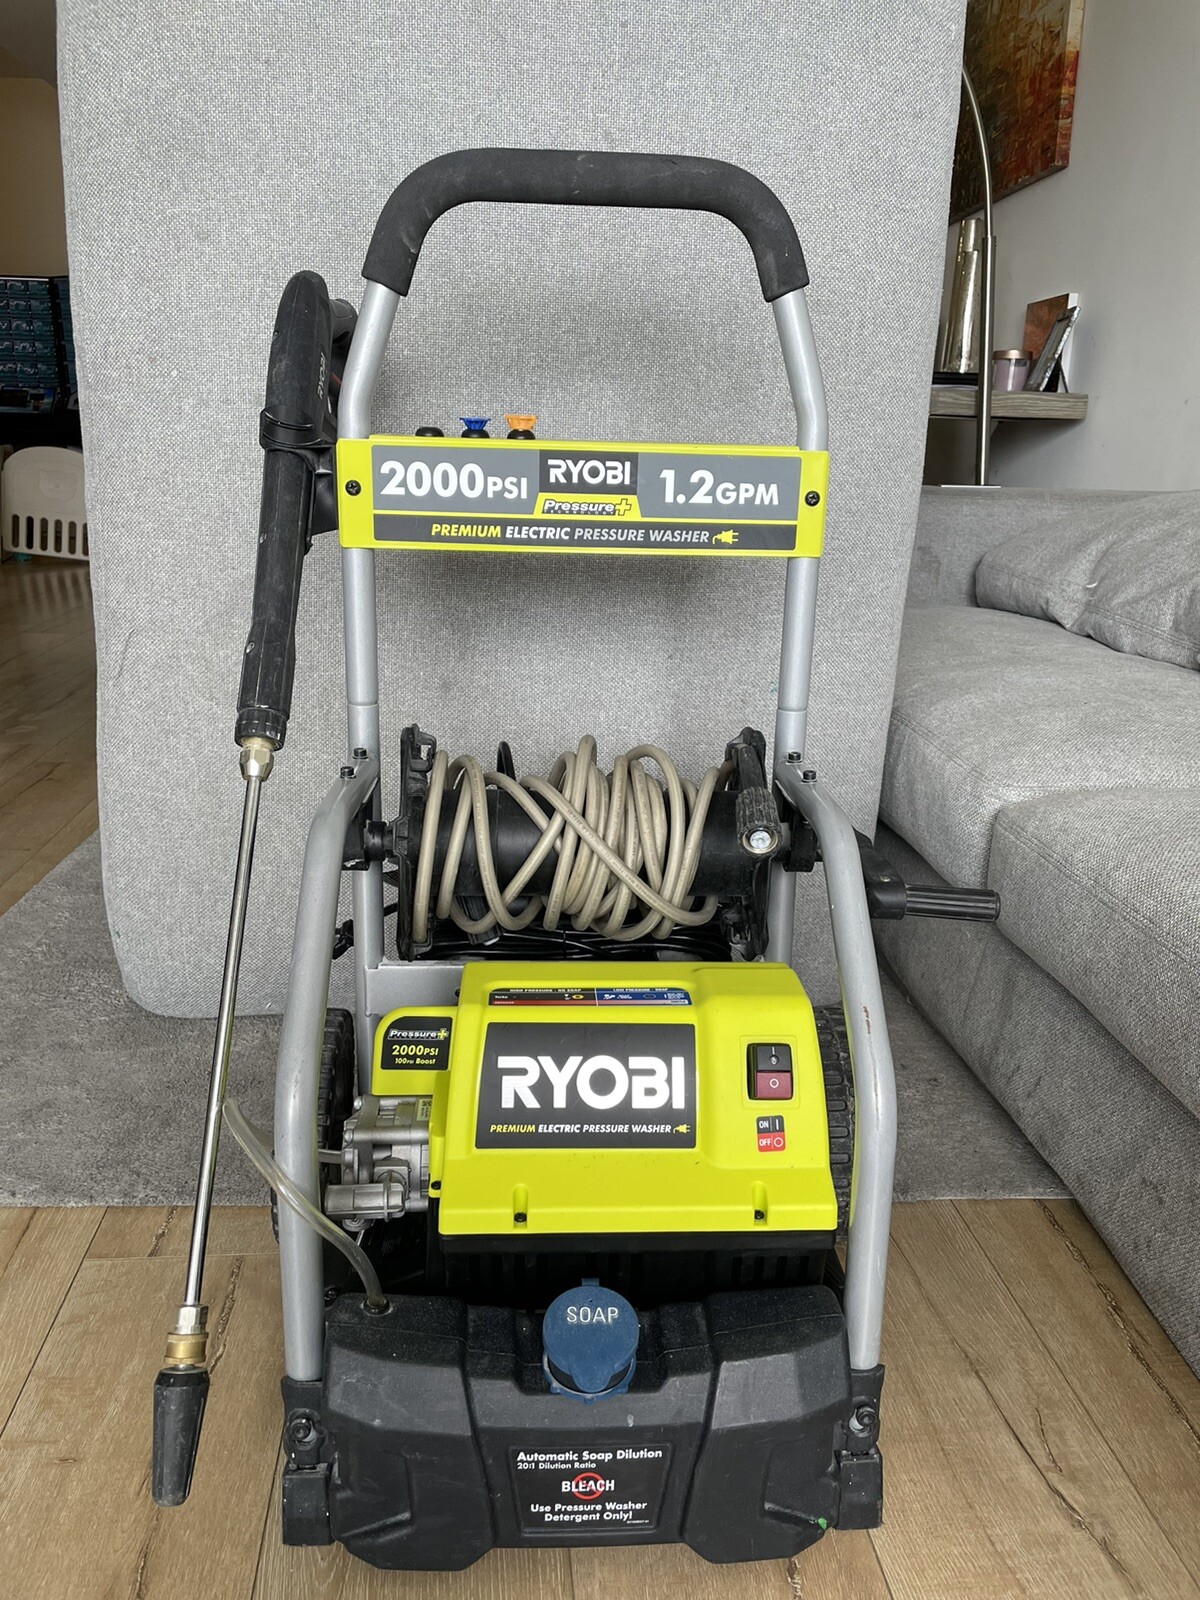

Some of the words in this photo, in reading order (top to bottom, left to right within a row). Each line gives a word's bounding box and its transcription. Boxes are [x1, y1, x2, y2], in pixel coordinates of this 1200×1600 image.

[547, 459, 631, 485] RYOBI
[431, 524, 501, 538] PREMIUM
[505, 526, 571, 540] ELECTRIC
[574, 527, 646, 542] PRESSURE
[649, 529, 710, 544] WASHER
[497, 1055, 686, 1109] RYOBI
[490, 1124, 536, 1133] PREMIUM
[538, 1124, 581, 1133] ELECTRIC
[582, 1124, 629, 1133] PRESSURE
[631, 1124, 672, 1133] WASHER
[758, 1120, 769, 1129] ON
[566, 1306, 618, 1323] SOAP
[517, 1451, 579, 1462] Automatic
[582, 1450, 613, 1462] Soap
[616, 1449, 663, 1460] Dilution
[517, 1462, 535, 1470] 20:1
[574, 1461, 596, 1469] Ratio
[561, 1480, 615, 1492] BLEACH
[530, 1503, 551, 1512] Use
[554, 1503, 603, 1512] Pressure
[605, 1501, 648, 1510] Washer
[544, 1513, 600, 1522] Detergent
[603, 1511, 633, 1521] Only!
